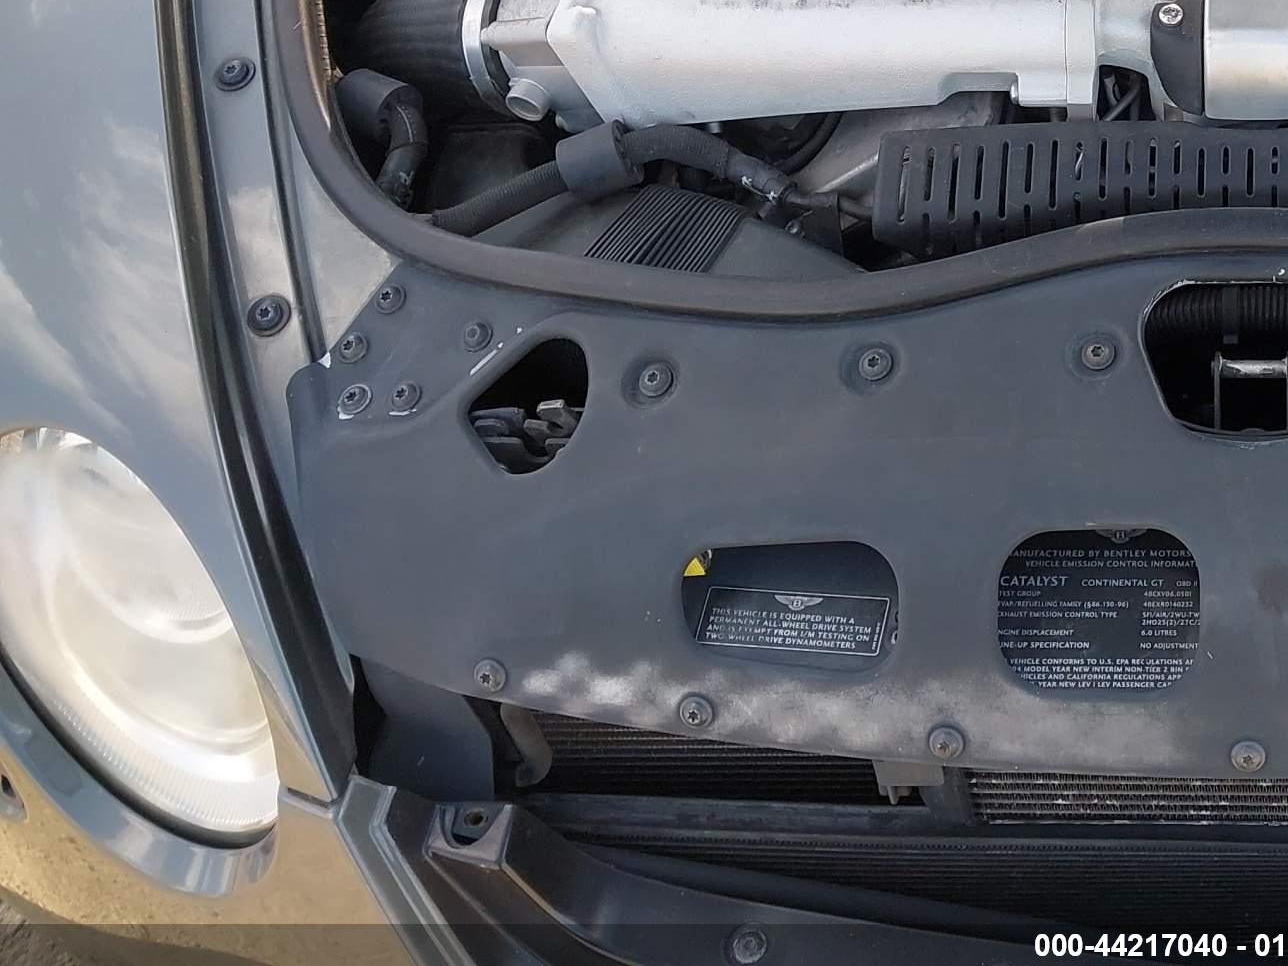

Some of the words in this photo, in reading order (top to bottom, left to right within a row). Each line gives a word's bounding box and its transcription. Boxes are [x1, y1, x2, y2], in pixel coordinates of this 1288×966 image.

[1008, 549, 1085, 557] ANUFACTURED
[1089, 549, 1100, 557] BY
[1104, 550, 1146, 558] BENTLEY
[1001, 575, 1069, 587] CATALYST
[1081, 579, 1148, 587] CONTINENTAL
[1151, 579, 1165, 587] GT
[734, 610, 768, 618] VEHICLE
[780, 612, 822, 622] EQUIPPED
[825, 616, 847, 624] WITH
[709, 616, 760, 625] PERMANENT
[763, 619, 810, 629] ALL-WHEEL
[812, 623, 838, 631] DRIVE
[839, 626, 872, 634] SYSTEM
[758, 636, 784, 644] DRIVE
[785, 637, 856, 649] DYNAMOMETERS
[818, 632, 853, 641] TESTING
[1030, 641, 1090, 649] SPECIFICATION
